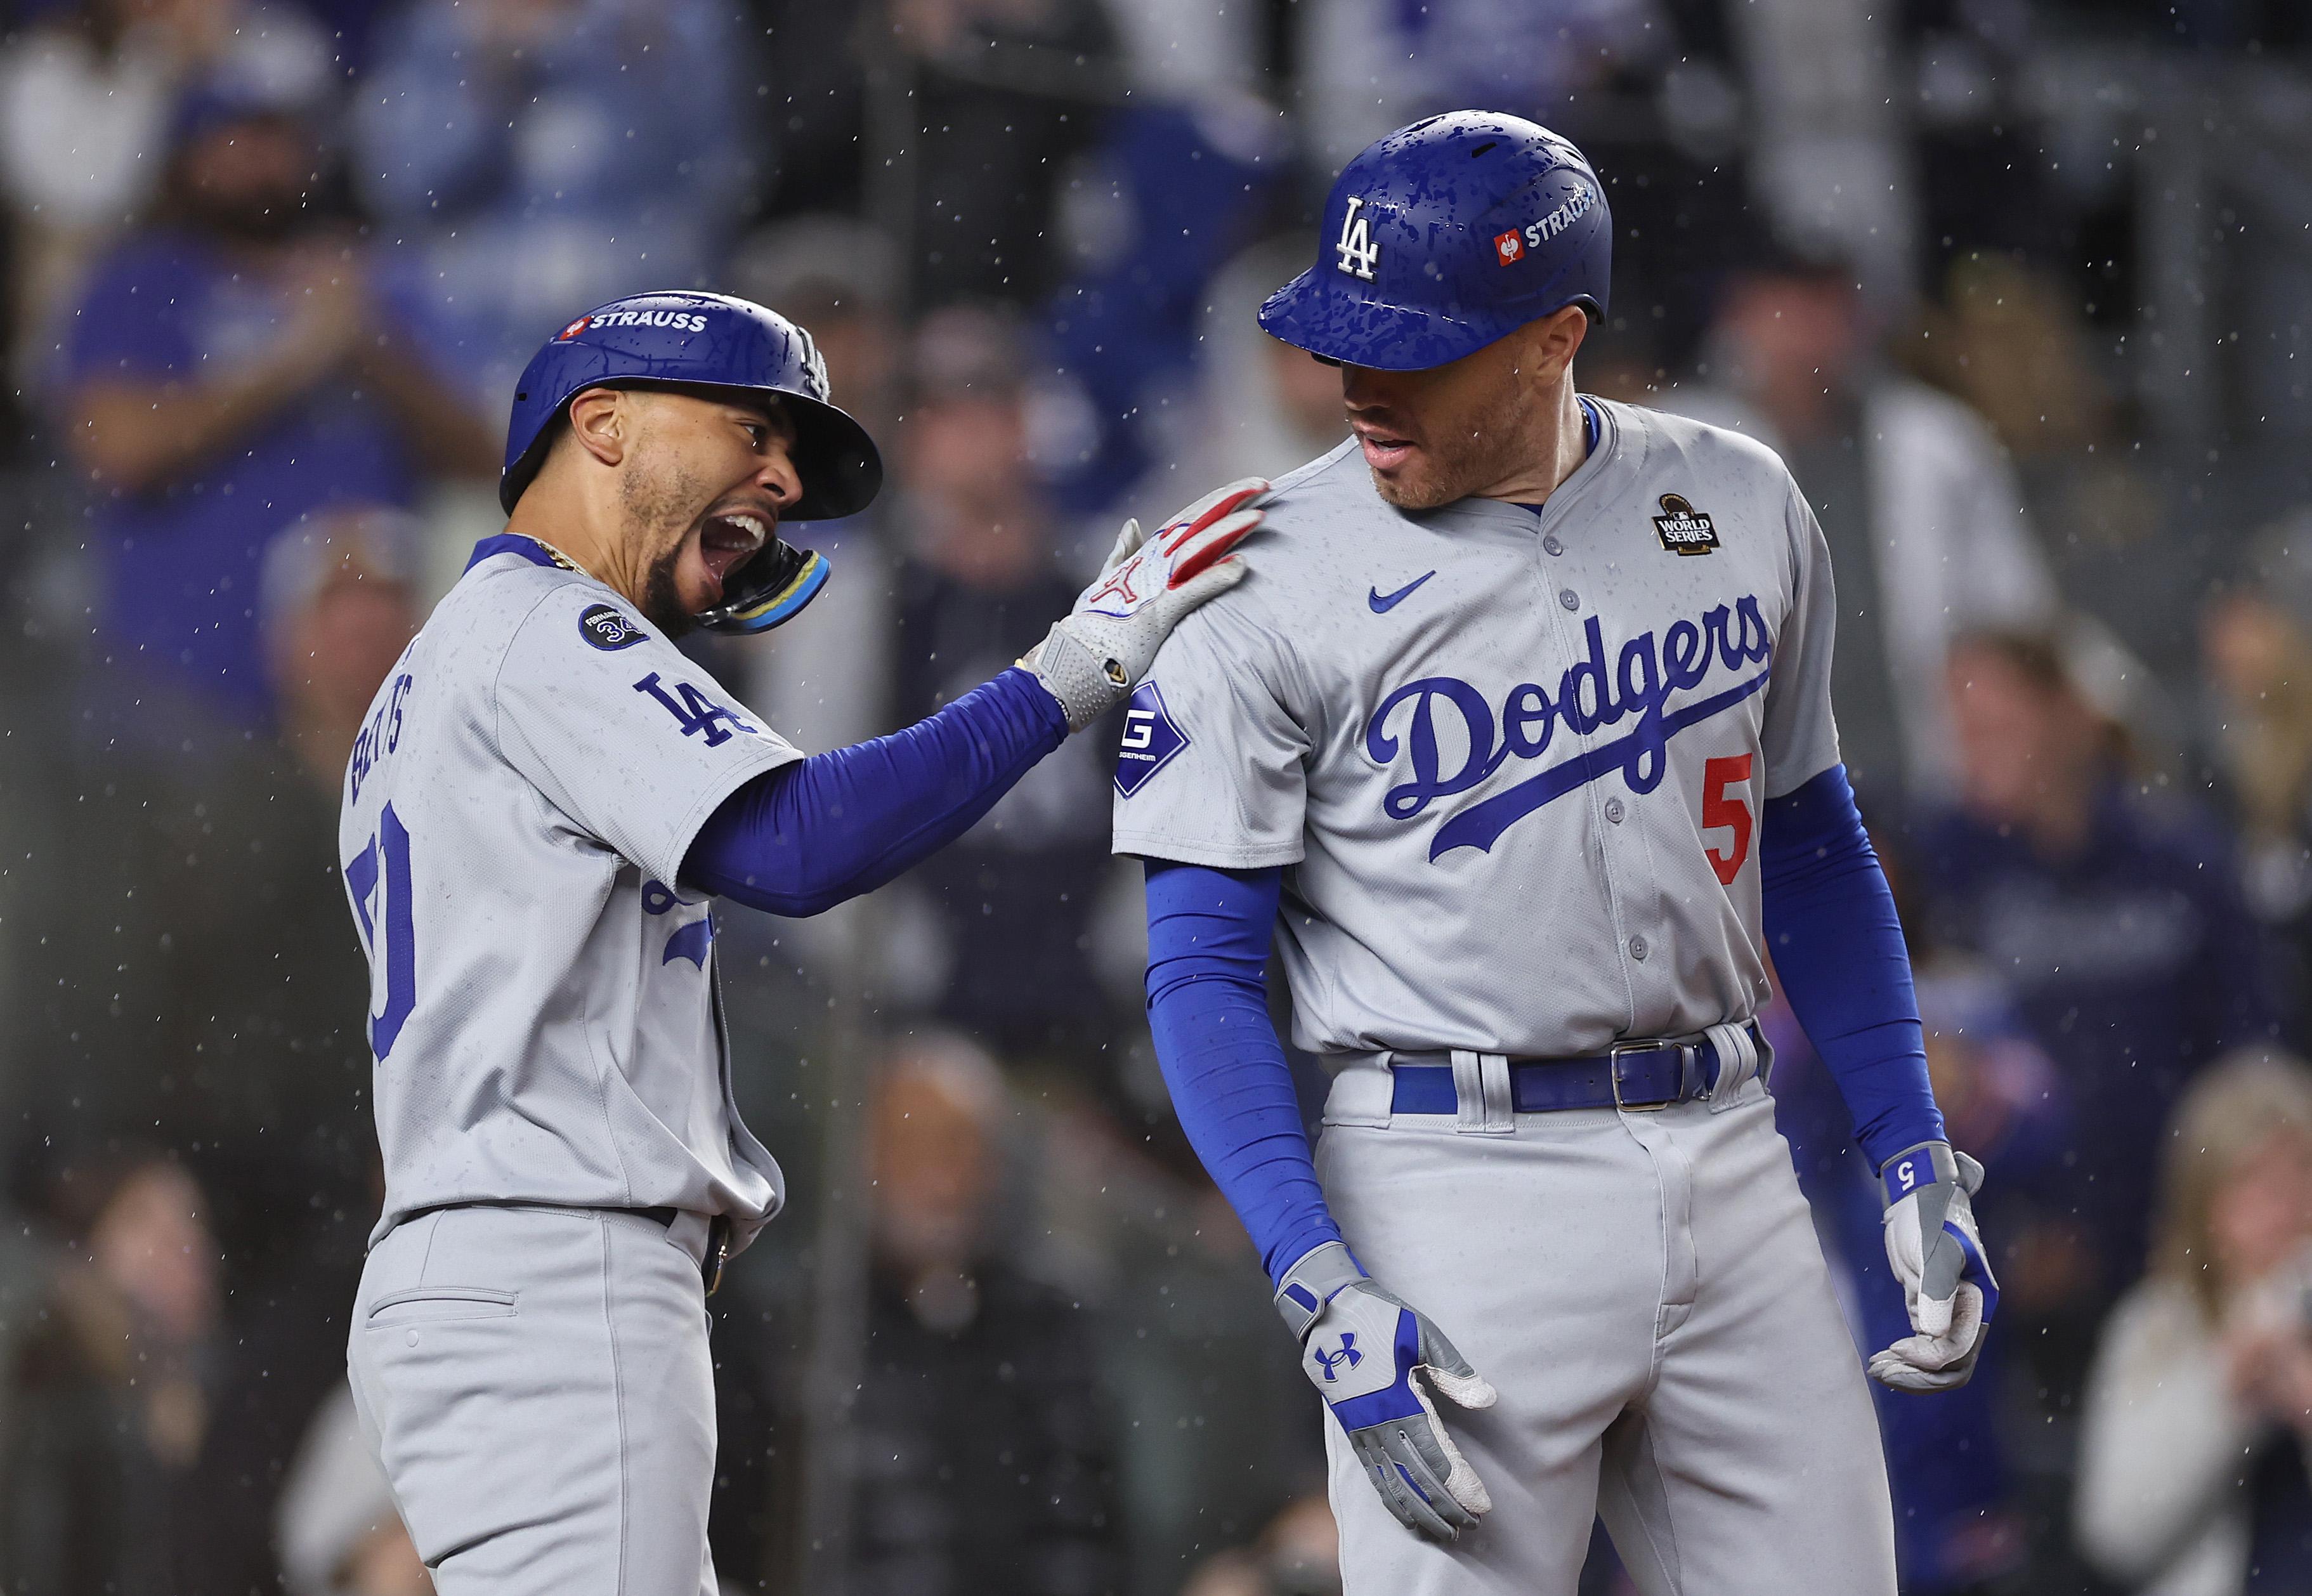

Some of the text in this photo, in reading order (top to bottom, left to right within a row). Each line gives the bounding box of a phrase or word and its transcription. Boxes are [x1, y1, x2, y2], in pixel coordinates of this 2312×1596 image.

[1336, 195, 1378, 280] LA
[1525, 182, 1596, 247] STRAUSS
[589, 311, 708, 332] STRAUSS
[1657, 519, 1710, 532] WORLD
[1665, 530, 1713, 542] SERIES
[632, 671, 758, 747] LA
[1366, 594, 1771, 820] Dodgers
[1702, 753, 1752, 885] 5
[1897, 1161, 1915, 1191] 5
